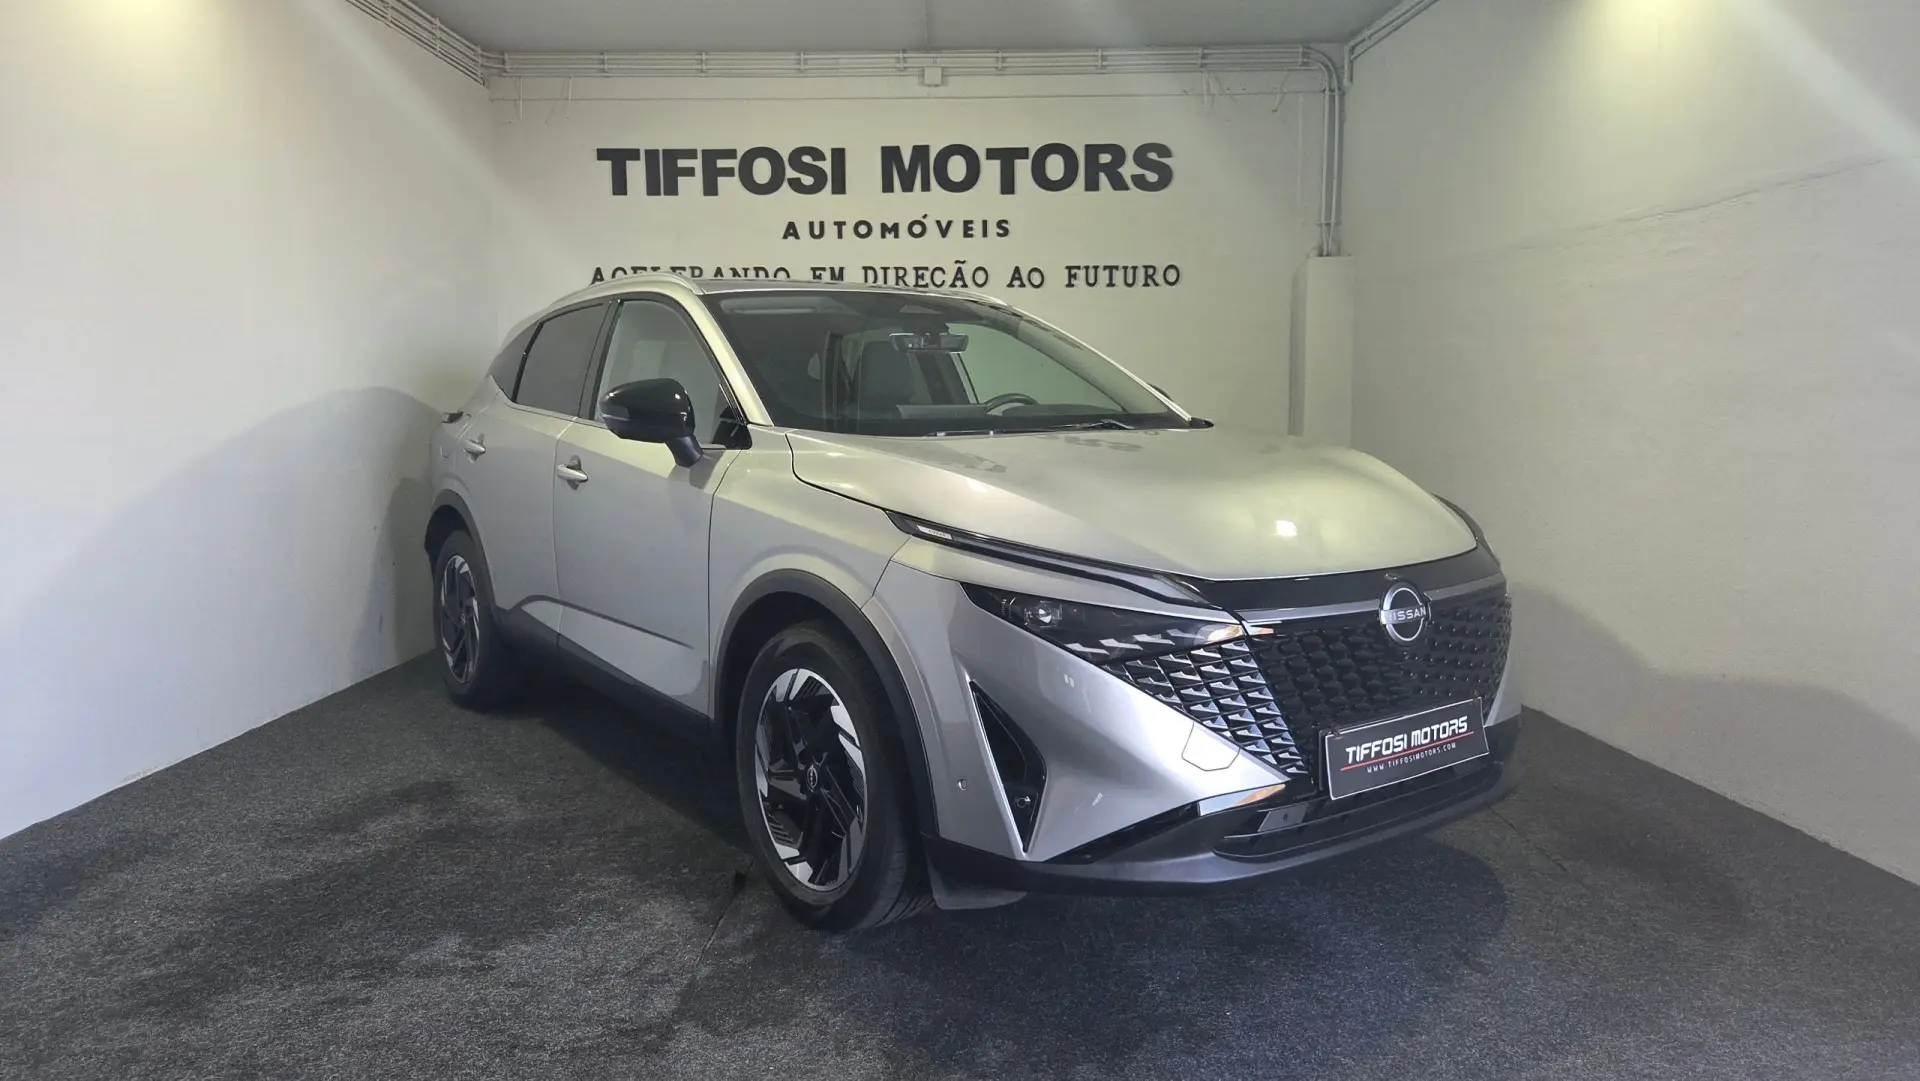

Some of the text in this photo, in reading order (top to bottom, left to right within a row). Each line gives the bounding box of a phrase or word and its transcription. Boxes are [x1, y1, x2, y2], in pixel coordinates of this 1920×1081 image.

[596, 142, 1174, 196] TIFFOSI MOTORS
[782, 213, 1010, 240] AUTOMÓVEIS
[810, 266, 845, 282] EM
[1006, 266, 1045, 289] AO
[1064, 264, 1181, 288] FUTURO
[1345, 715, 1468, 764] TIFFOSI MOTORS
